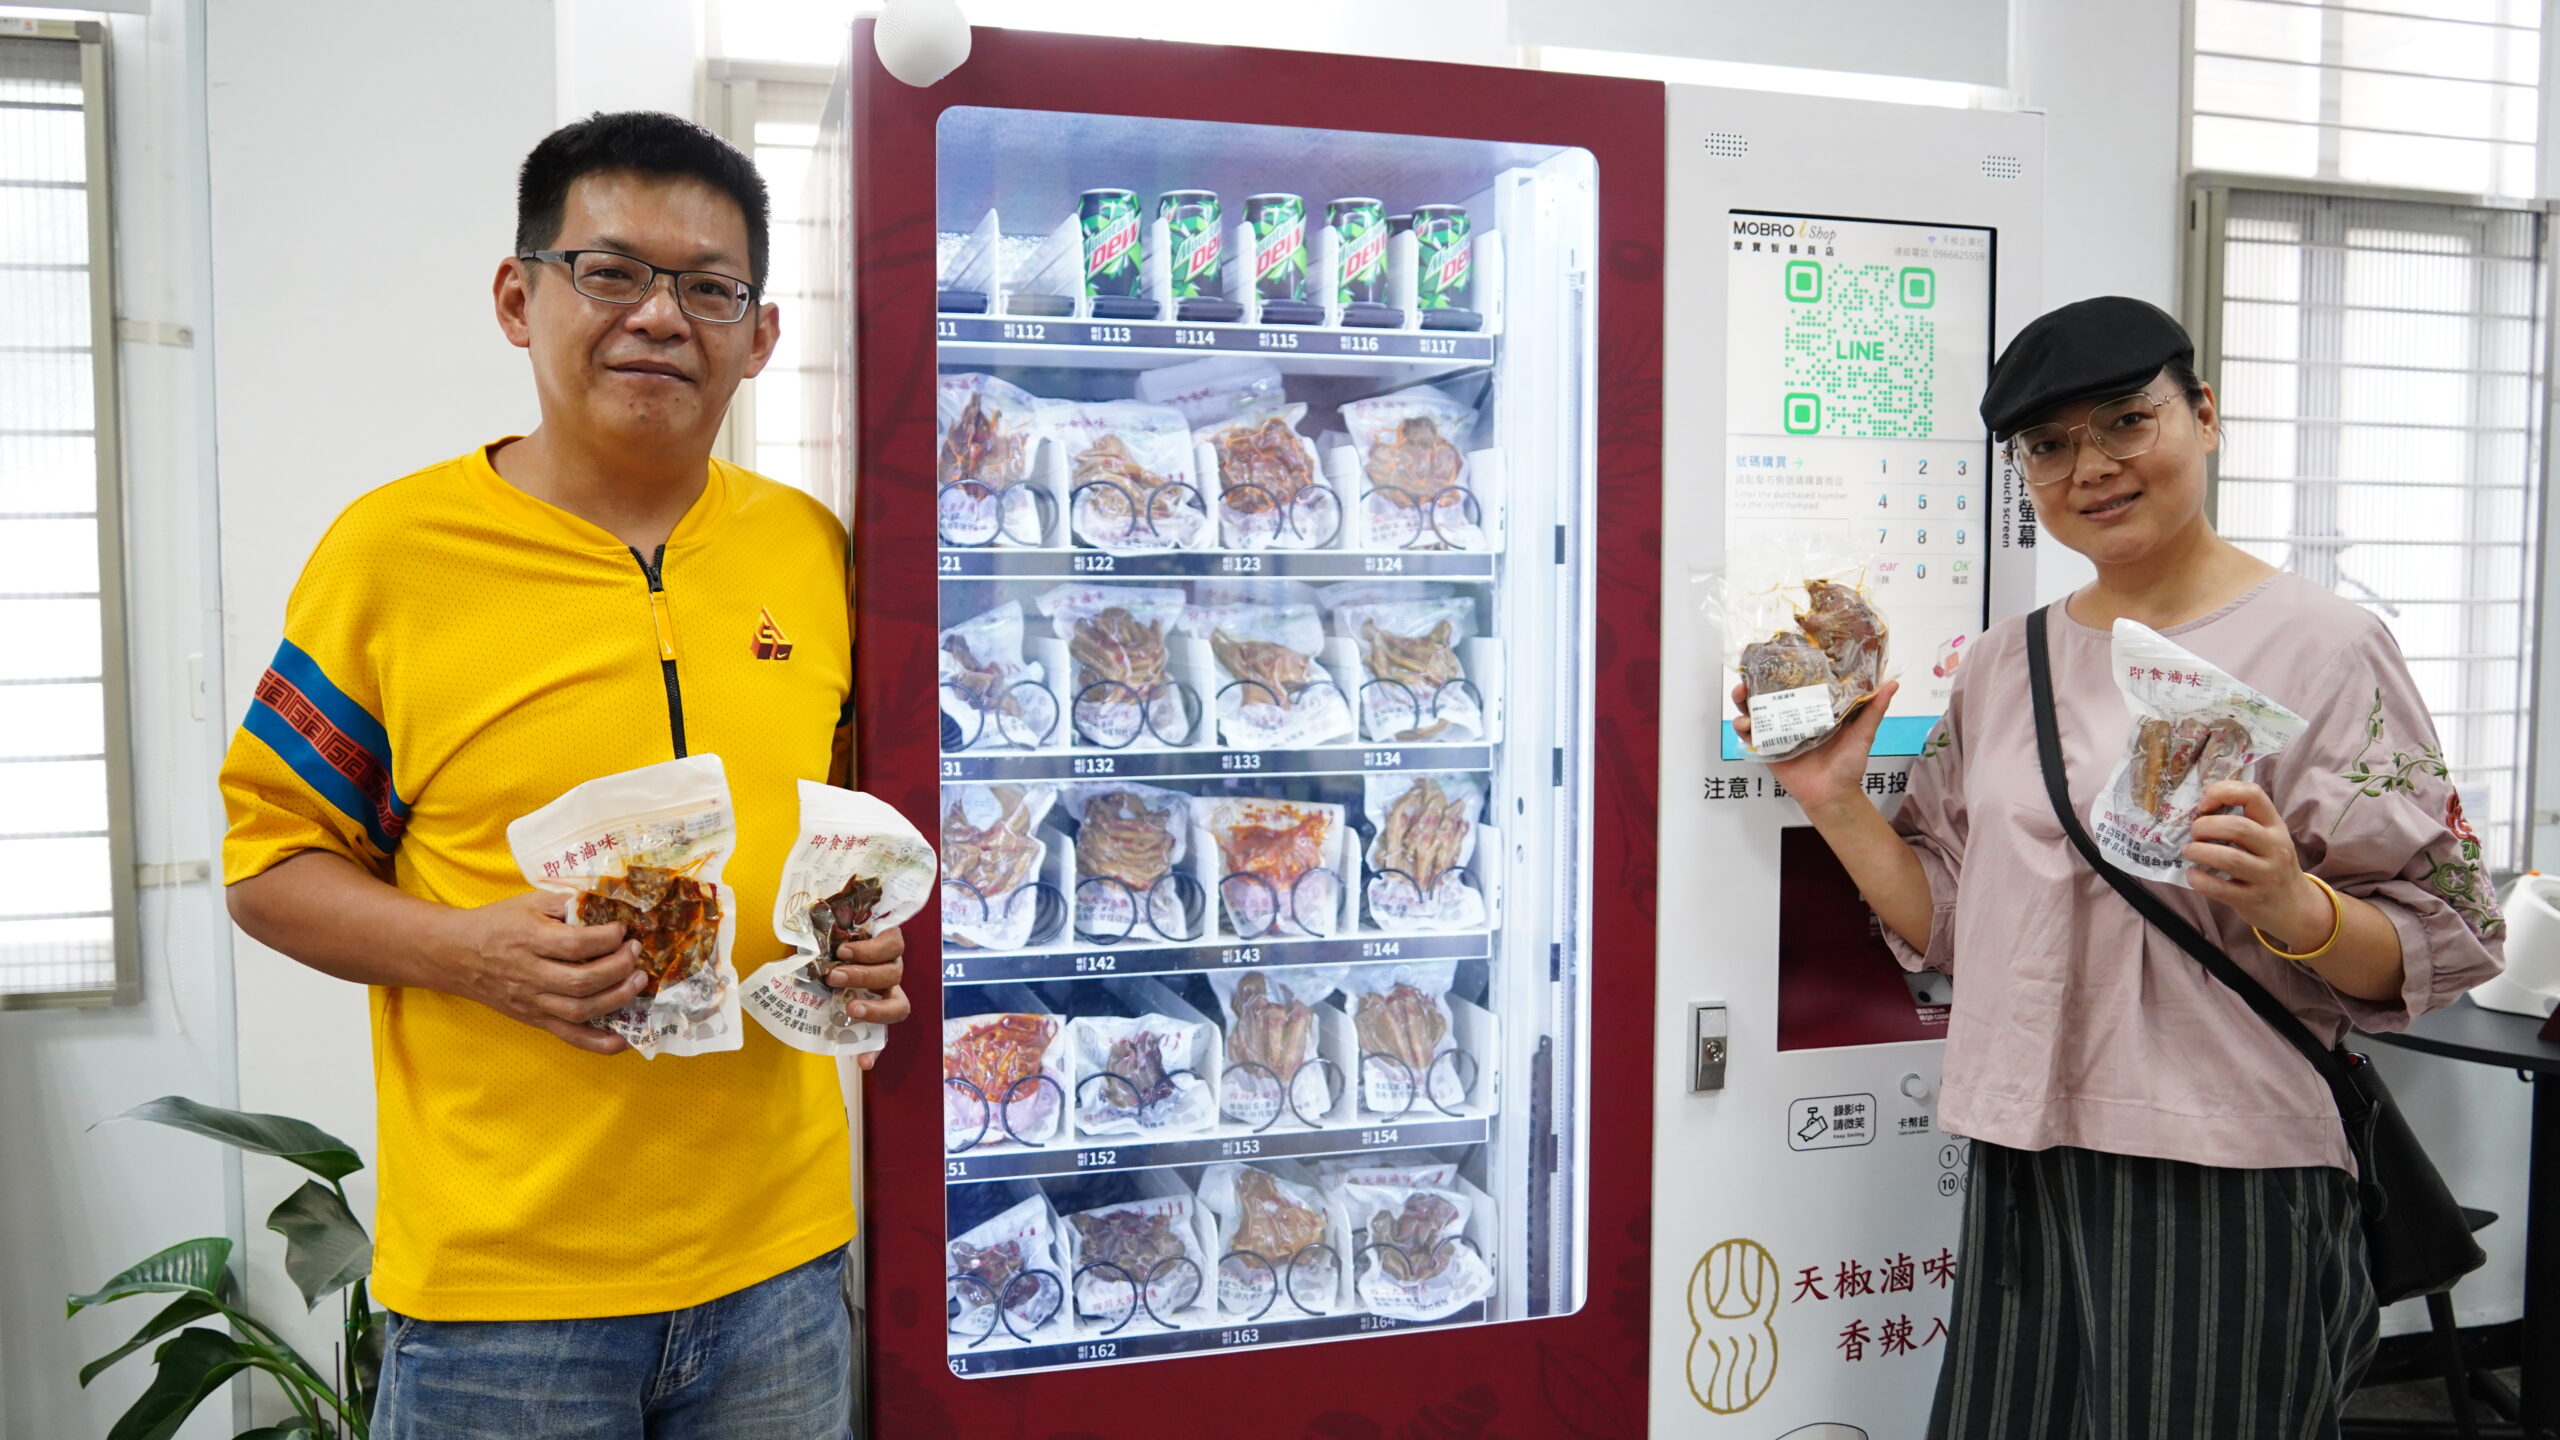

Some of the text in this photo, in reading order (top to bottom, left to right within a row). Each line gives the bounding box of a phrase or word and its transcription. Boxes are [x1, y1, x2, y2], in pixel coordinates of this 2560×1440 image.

[1733, 221, 1795, 238] MOBRO
[1809, 226, 1836, 244] Shop
[1016, 324, 1045, 340] 112
[1102, 327, 1131, 343] 113
[1188, 330, 1216, 345] 114
[1271, 333, 1299, 349] 115
[1351, 336, 1379, 352] 116
[1431, 339, 1457, 354] 117
[1836, 340, 1885, 361] LINE
[1880, 459, 1888, 474] 1
[1918, 459, 1928, 475] 2
[1957, 460, 1967, 476] 3
[2003, 469, 2012, 504] touch
[1818, 491, 1848, 500] number
[1878, 494, 1889, 509] 4
[1918, 494, 1927, 510] 5
[1957, 495, 1966, 510] 6
[2002, 507, 2011, 548] screen
[1878, 529, 1887, 544] 7
[1917, 529, 1927, 545] 8
[1956, 529, 1966, 545] 9
[940, 556, 962, 571] 21
[1086, 555, 1114, 571] 122
[1234, 556, 1261, 571] 123
[1376, 557, 1402, 571] 124
[1953, 560, 1970, 572] OK
[1917, 564, 1926, 579] 0
[2129, 665, 2203, 688] 即食滷味
[1086, 758, 1114, 773] 132
[1233, 754, 1260, 769] 133
[1374, 751, 1401, 766] 134
[942, 761, 962, 776] 31
[810, 834, 871, 851] 即食滷味
[542, 832, 619, 880] 即食滷味
[1233, 948, 1260, 963] 143
[1373, 942, 1400, 956] 144
[944, 963, 965, 978] 41
[1087, 956, 1116, 971] 142
[1833, 1103, 1865, 1117] 錄影中
[1833, 1117, 1865, 1131] 請微笑
[1898, 1115, 1929, 1129] 卡幣鈕
[1372, 1129, 1398, 1144] 154
[1233, 1139, 1260, 1154] 153
[1088, 1151, 1117, 1166] 152
[1946, 1151, 1952, 1162] 1
[946, 1161, 967, 1176] 51
[1942, 1178, 1956, 1191] 10
[1791, 1247, 1958, 1304] 天椒滷味
[1233, 1328, 1260, 1343] 163
[1089, 1343, 1117, 1358] 162
